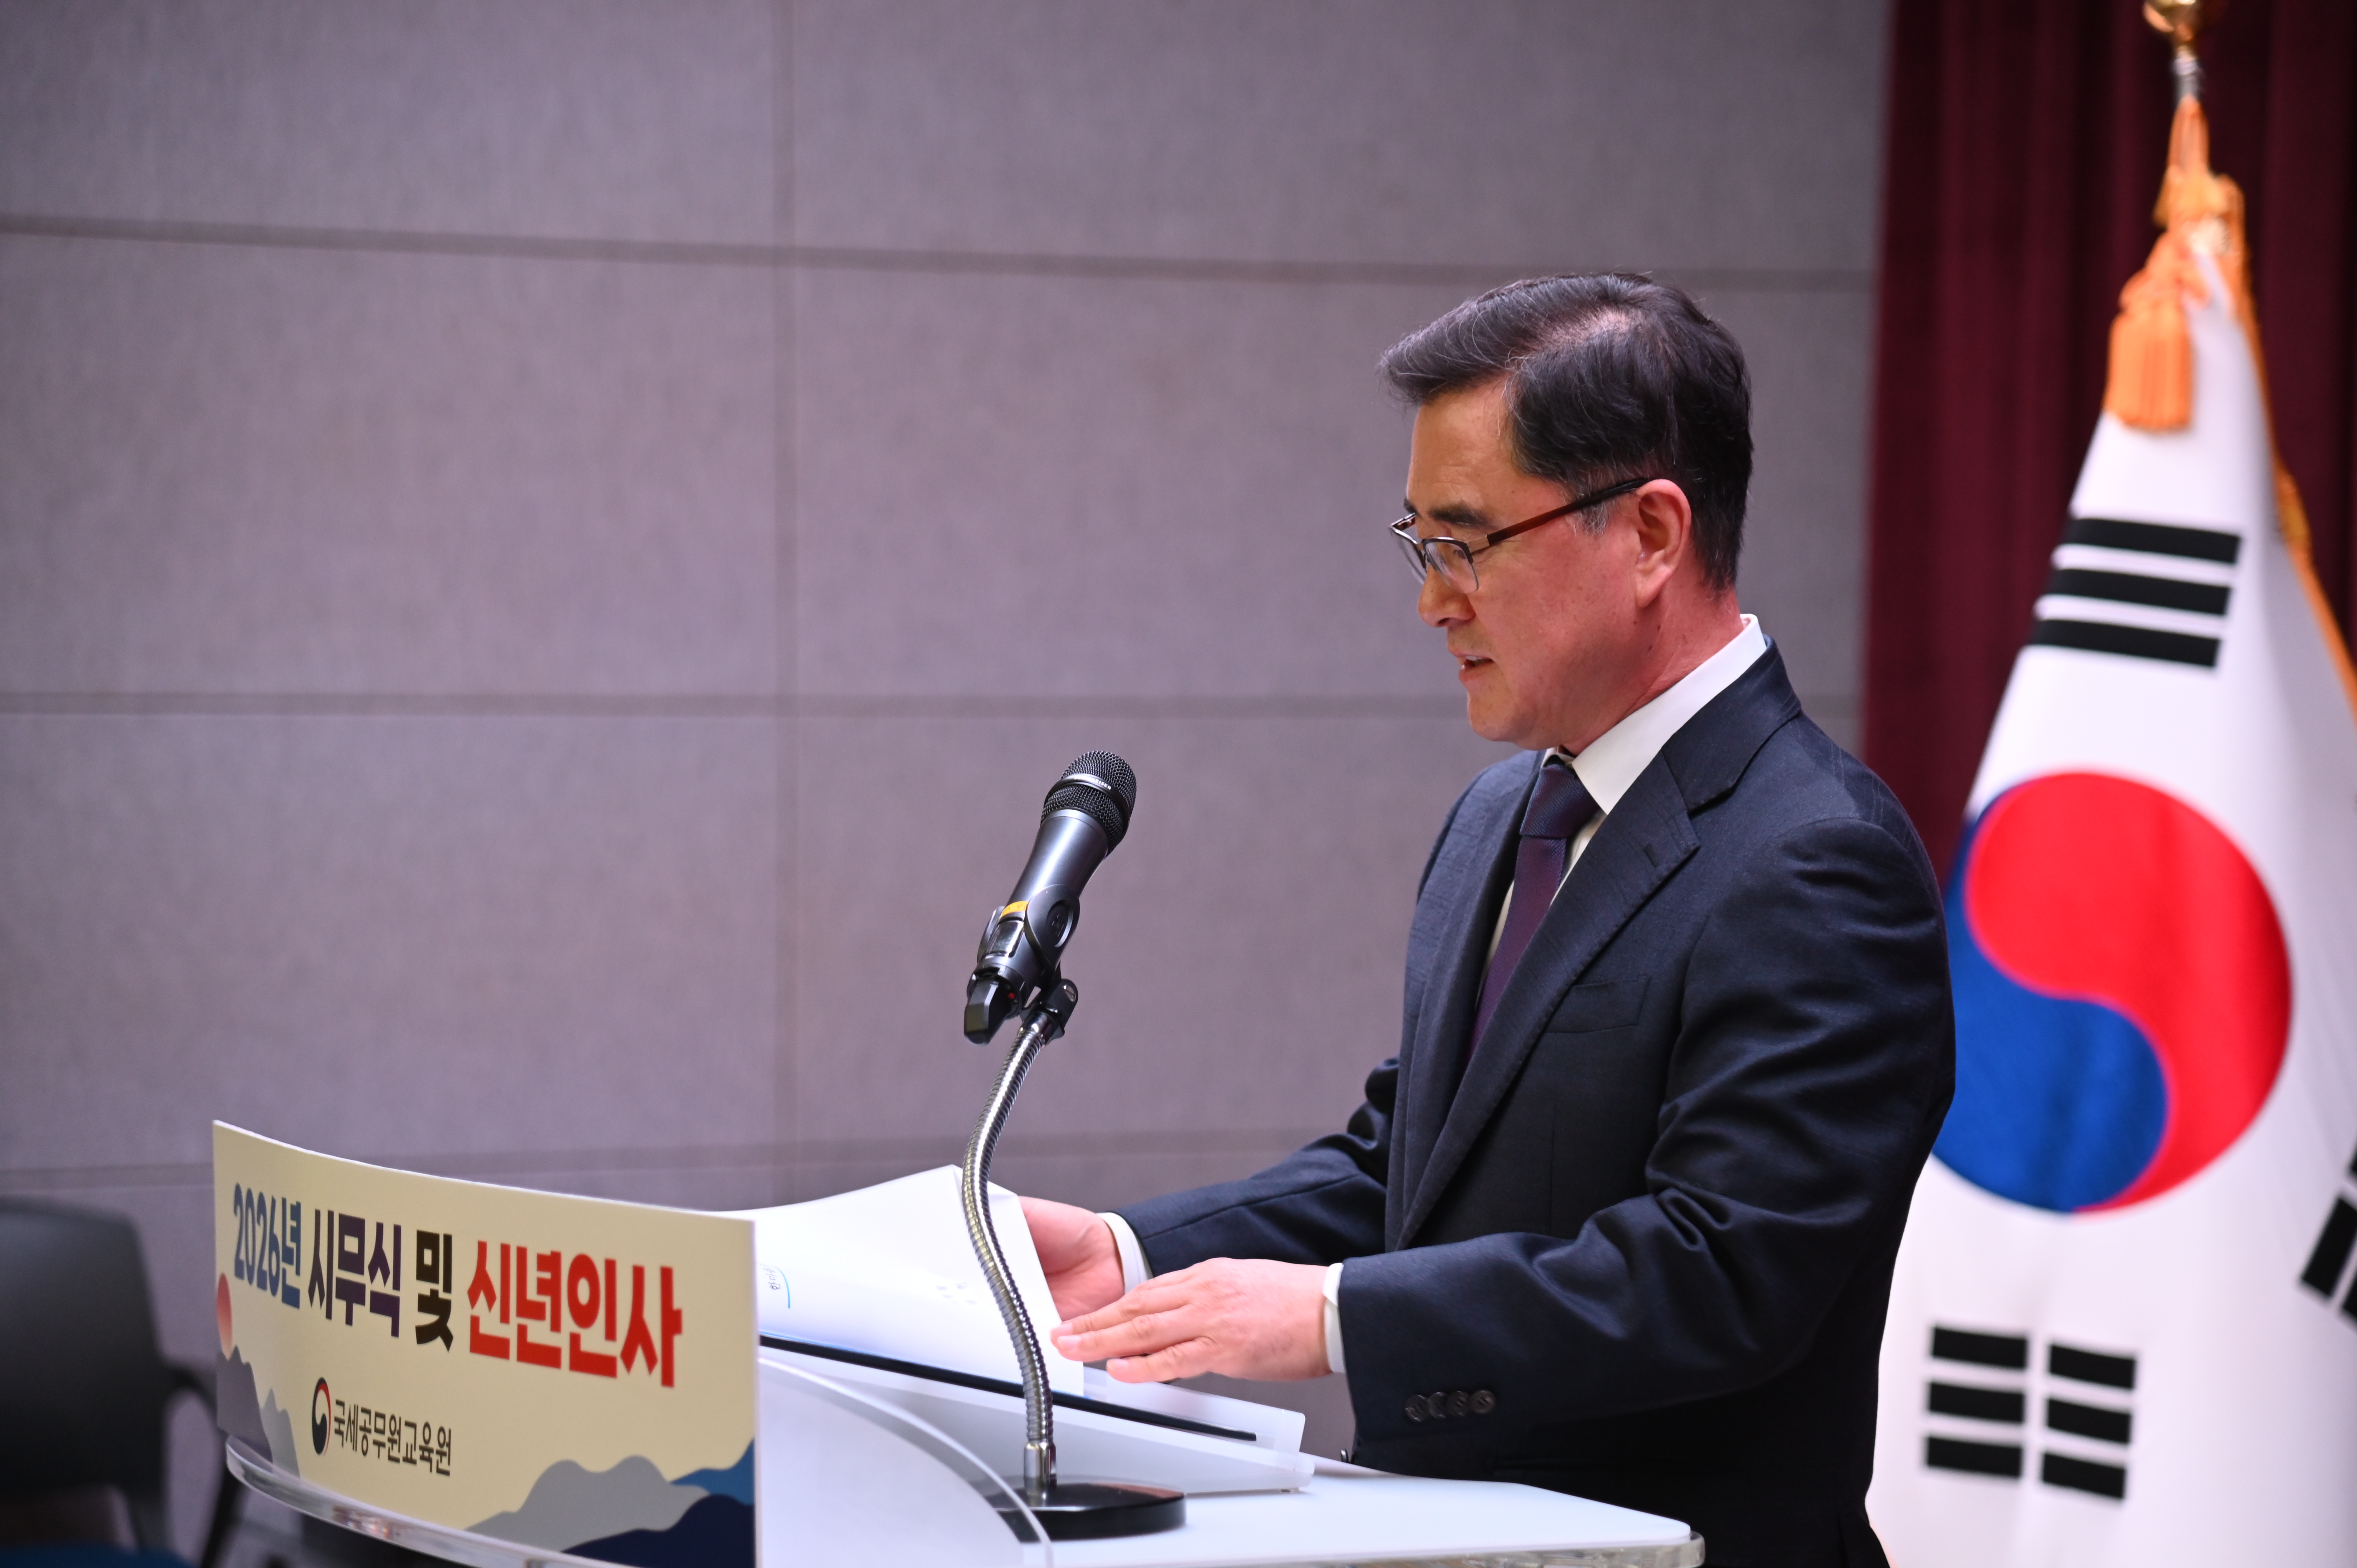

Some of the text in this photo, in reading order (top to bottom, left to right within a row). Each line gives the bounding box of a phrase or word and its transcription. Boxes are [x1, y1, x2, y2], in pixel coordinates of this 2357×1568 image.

[234, 1183, 682, 1388] 2026년 시무식 및 신년인사
[334, 1399, 451, 1477] 국세공무원교육원
